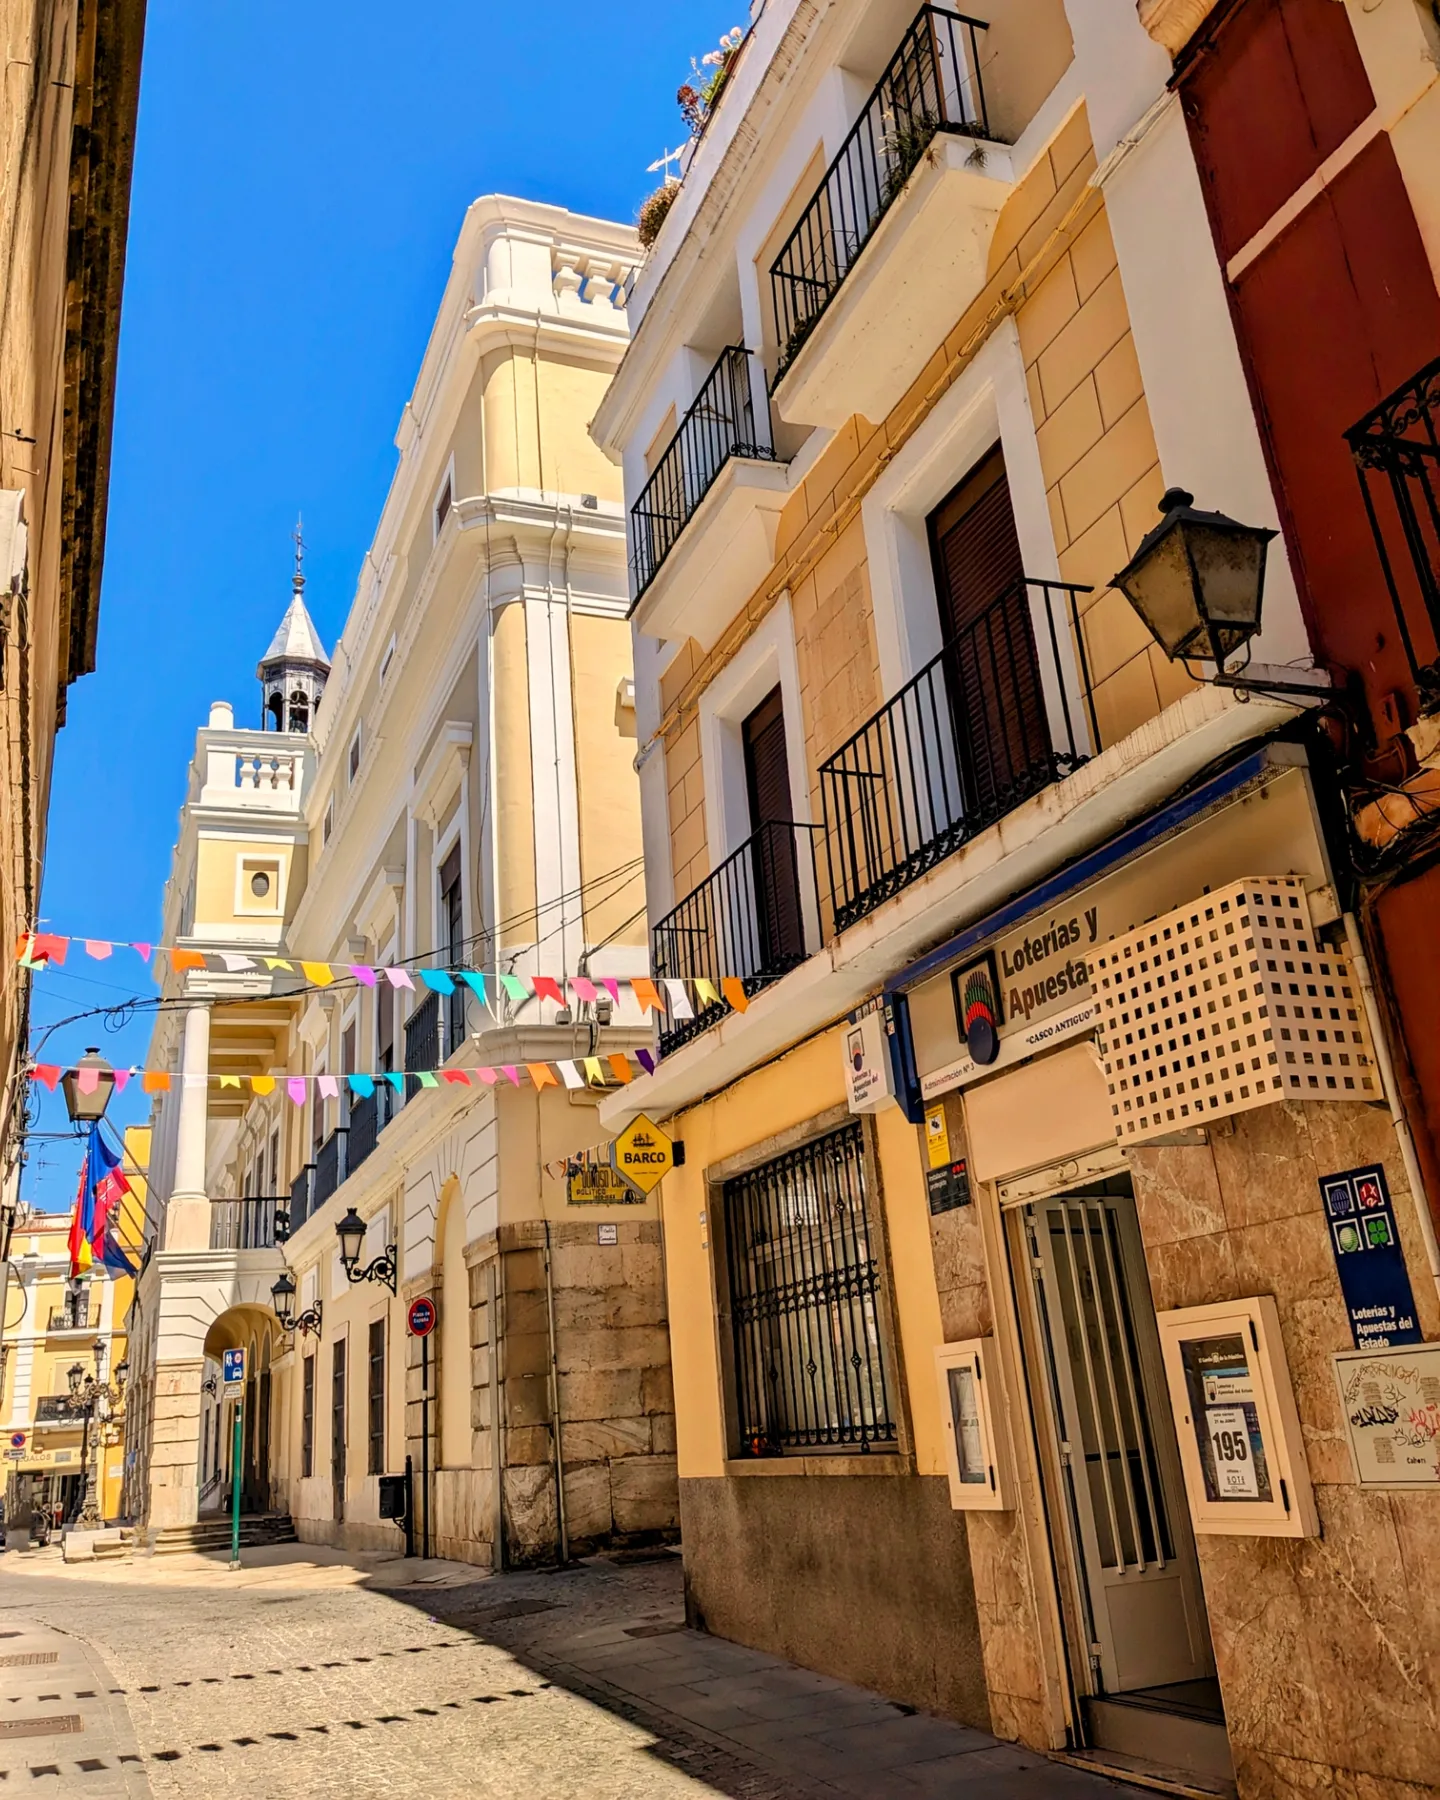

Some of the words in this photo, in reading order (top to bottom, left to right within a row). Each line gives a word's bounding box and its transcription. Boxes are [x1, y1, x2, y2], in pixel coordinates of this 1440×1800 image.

[1001, 919, 1080, 978] Loterías
[1084, 906, 1097, 942] y
[1009, 960, 1089, 1020] Apuesta
[924, 1069, 962, 1091] Administración
[970, 1062, 975, 1071] 3
[624, 1152, 666, 1164] BARCO
[1351, 1305, 1388, 1320] Loterías
[1389, 1305, 1395, 1318] y
[1356, 1320, 1397, 1337] Apuestas
[1398, 1316, 1414, 1330] del
[1358, 1335, 1390, 1350] Estado
[1212, 1431, 1247, 1461] 195
